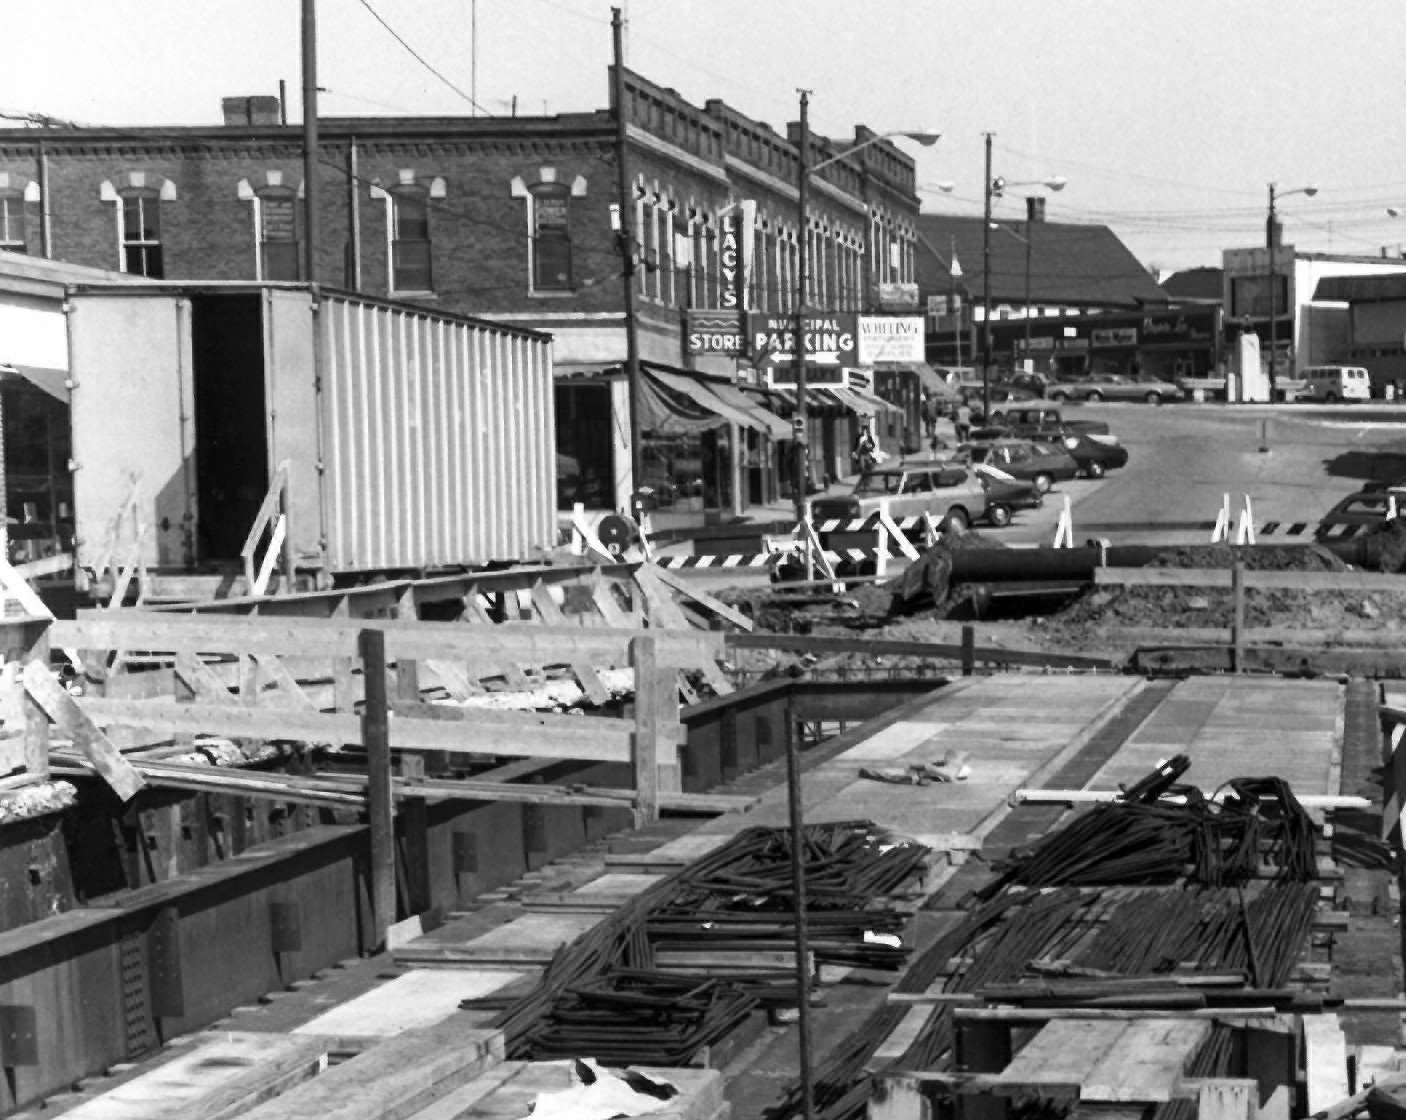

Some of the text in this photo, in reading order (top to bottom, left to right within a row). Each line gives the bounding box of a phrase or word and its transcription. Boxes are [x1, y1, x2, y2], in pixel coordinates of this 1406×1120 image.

[722, 216, 737, 307] LACY'S
[767, 319, 840, 331] MUNIPAL
[689, 333, 745, 350] STORE
[755, 332, 854, 351] PARKING
